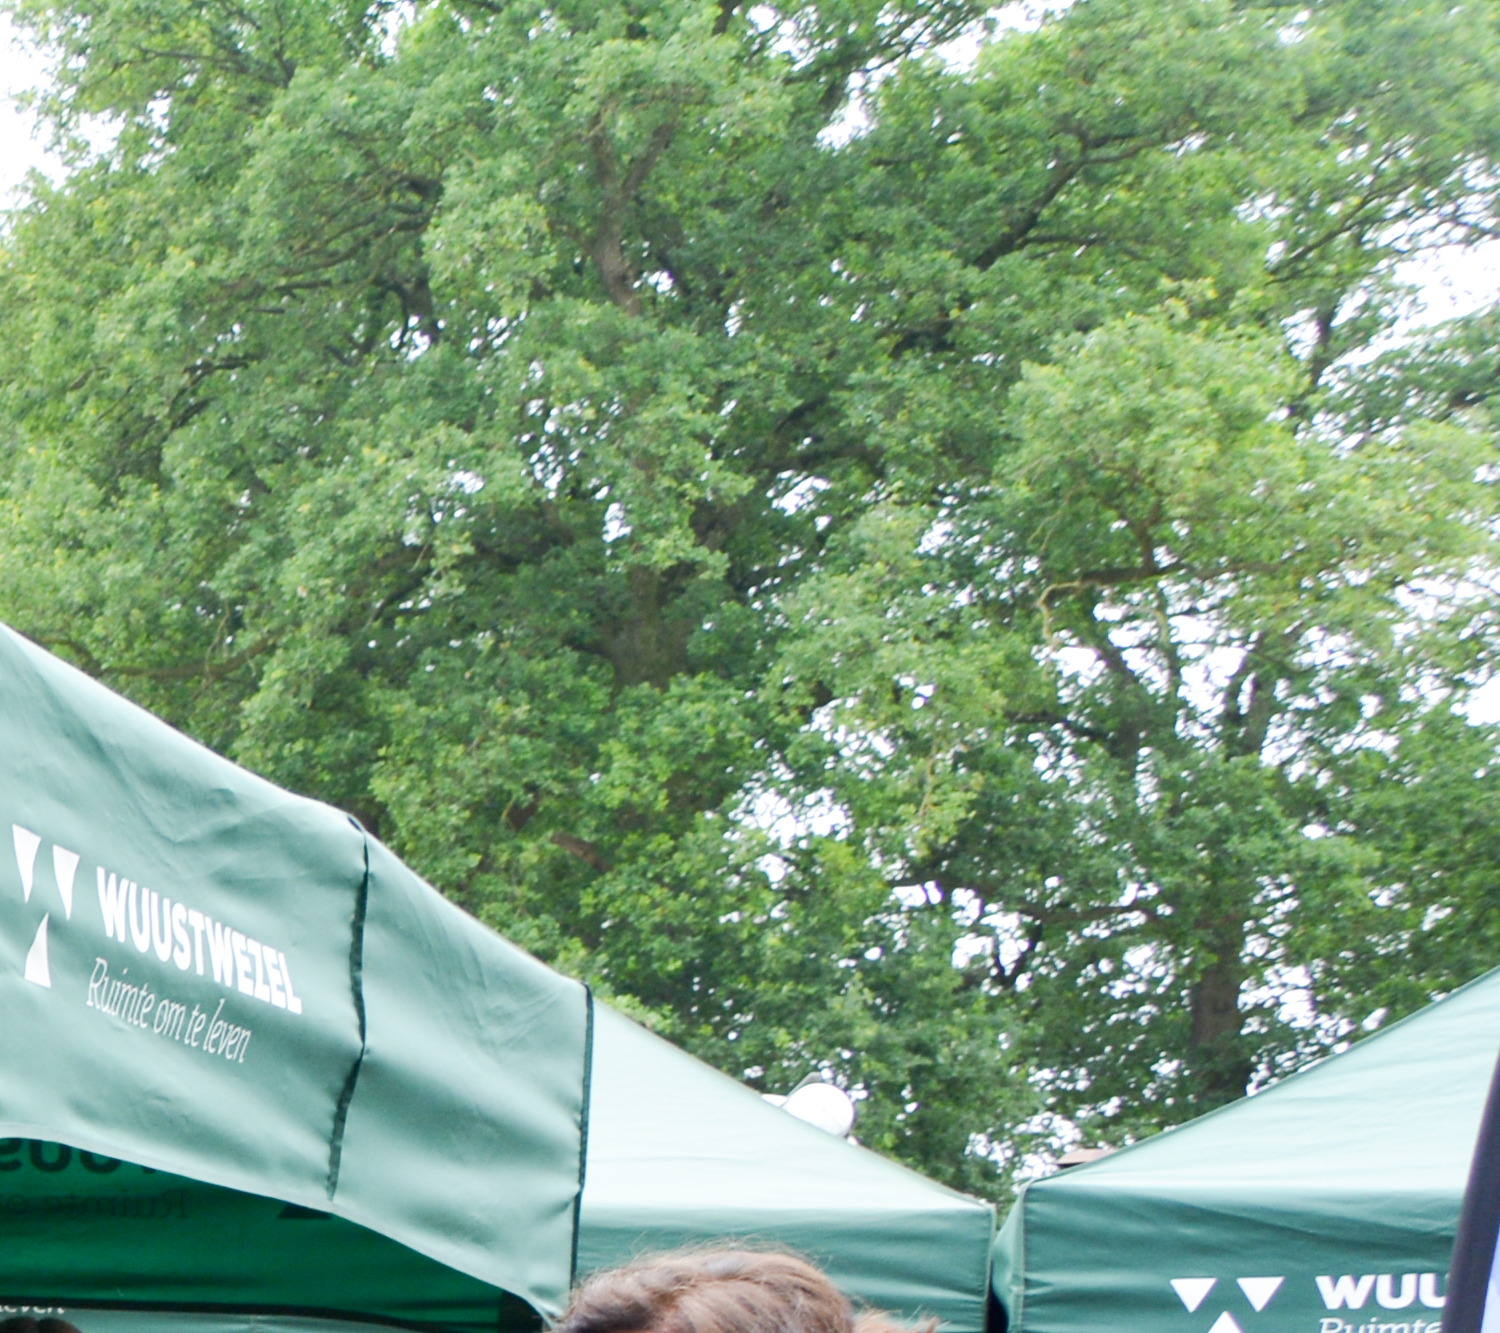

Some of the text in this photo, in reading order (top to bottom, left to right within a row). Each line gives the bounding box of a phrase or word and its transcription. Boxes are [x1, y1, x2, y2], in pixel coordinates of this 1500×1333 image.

[96, 866, 302, 1015] WUUSTWEZEL
[86, 957, 252, 1063] Ruimte om te leven
